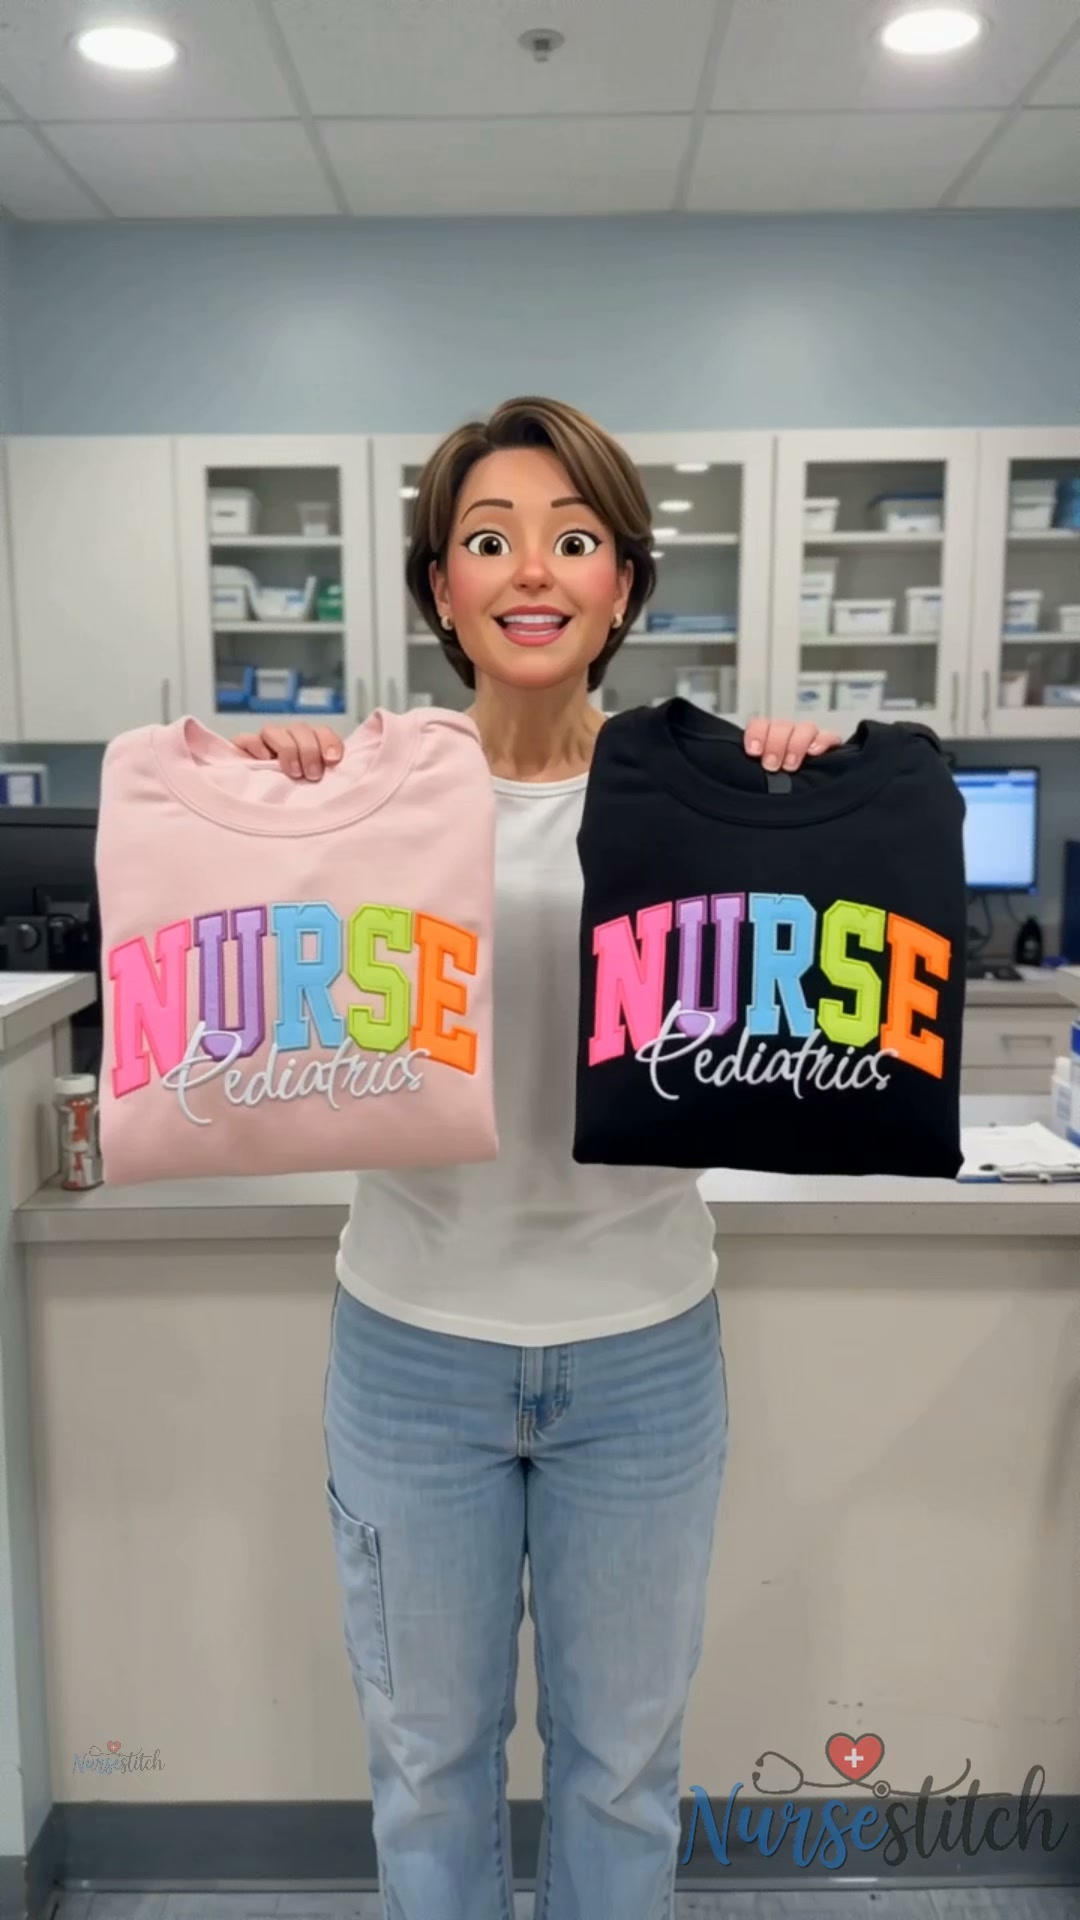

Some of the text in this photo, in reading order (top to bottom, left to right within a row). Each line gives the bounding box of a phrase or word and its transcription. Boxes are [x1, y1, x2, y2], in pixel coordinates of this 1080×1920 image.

[108, 901, 478, 1099] NURSE
[588, 892, 951, 1079] NURSE
[635, 1000, 899, 1099] Pediatrics
[162, 1021, 431, 1125] Pediatrics
